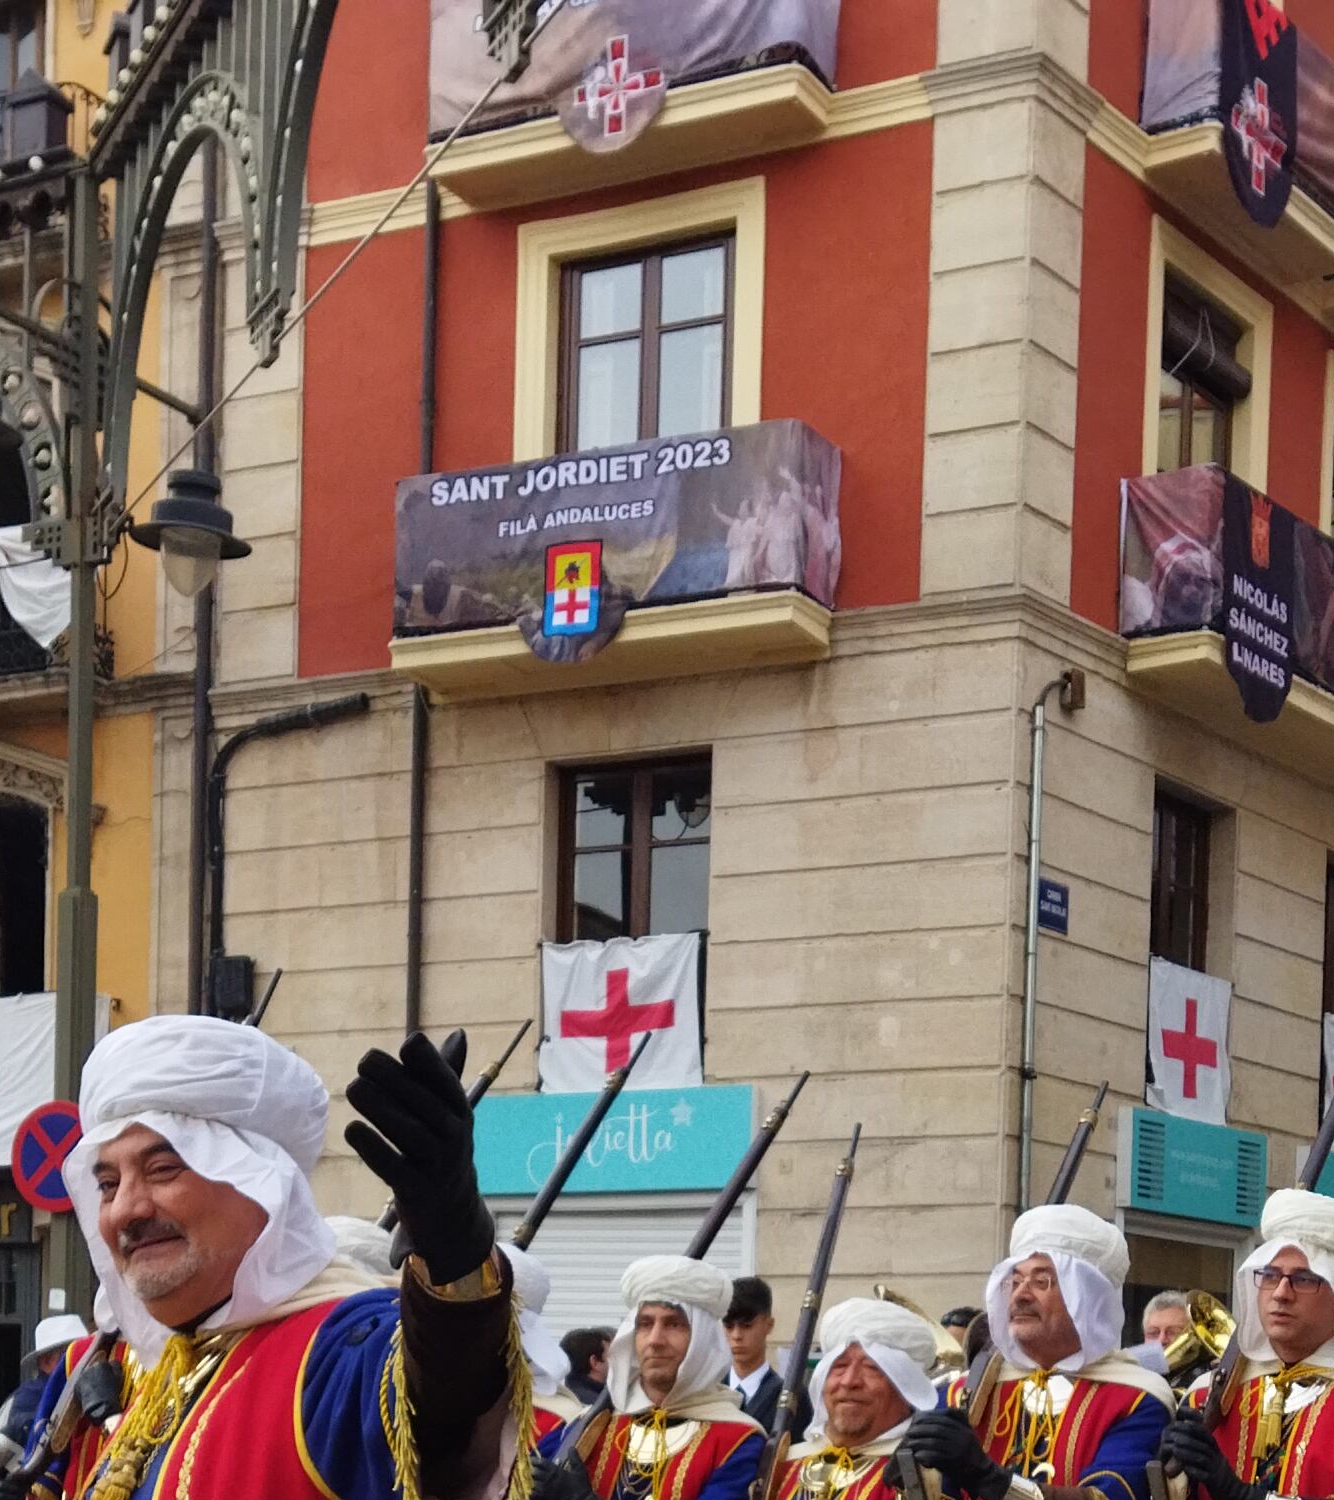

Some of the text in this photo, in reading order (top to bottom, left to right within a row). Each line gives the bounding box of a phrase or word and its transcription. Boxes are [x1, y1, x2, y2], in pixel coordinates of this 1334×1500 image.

[431, 438, 732, 506] SANT JORDIET 2023
[543, 499, 655, 530] ANDALUCES
[1233, 573, 1288, 624] NICOLÁS
[1229, 607, 1289, 658] SÁNCHEZ
